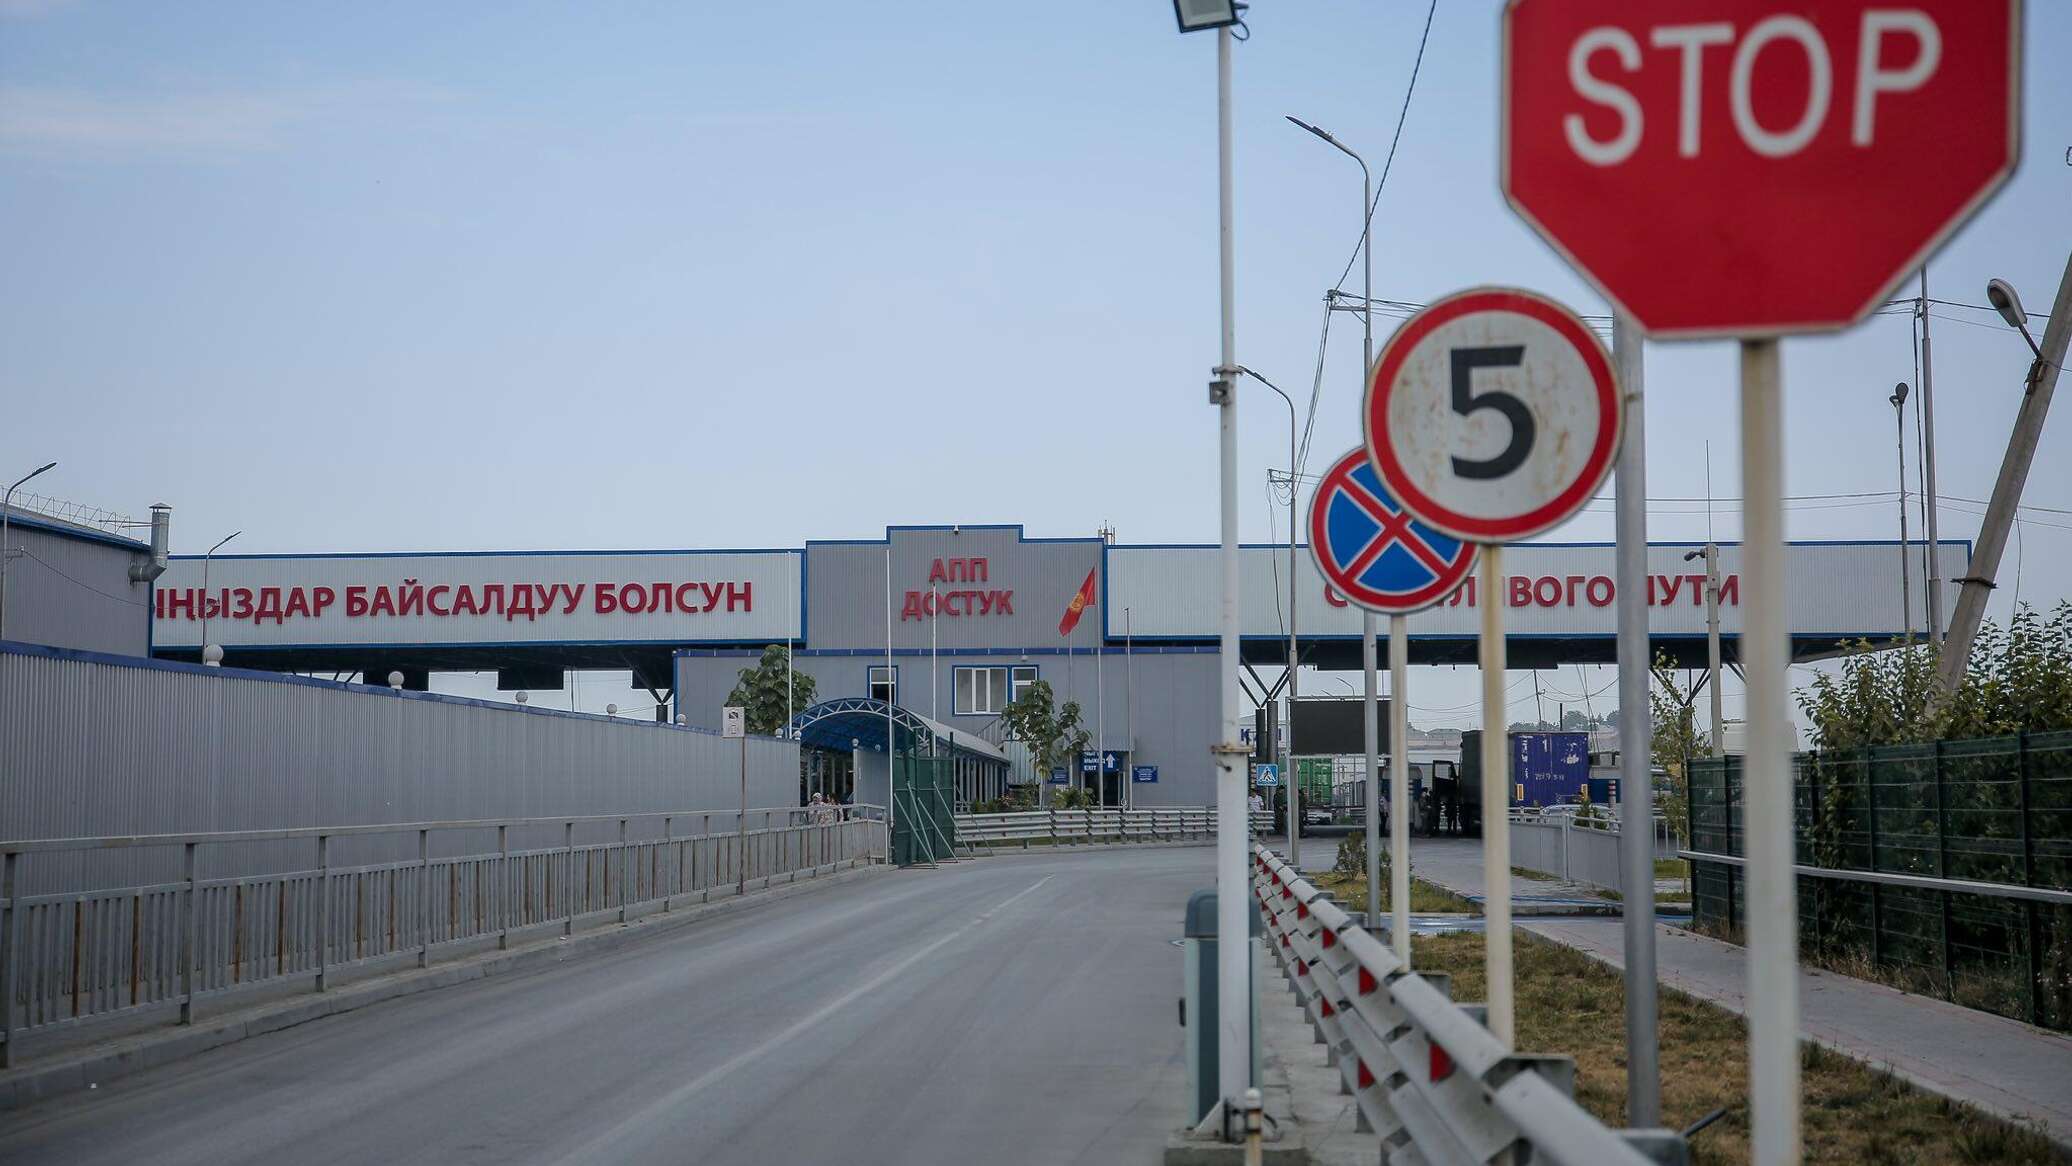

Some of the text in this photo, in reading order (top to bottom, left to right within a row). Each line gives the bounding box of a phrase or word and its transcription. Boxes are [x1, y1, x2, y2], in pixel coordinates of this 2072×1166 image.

[1563, 9, 1942, 166] STOP
[1449, 344, 1537, 481] 5
[929, 557, 988, 582] АПП
[346, 578, 586, 622] БАЙСАЛДУУ
[595, 582, 752, 614] БОЛСУН
[901, 590, 1014, 621] ДОСТУК
